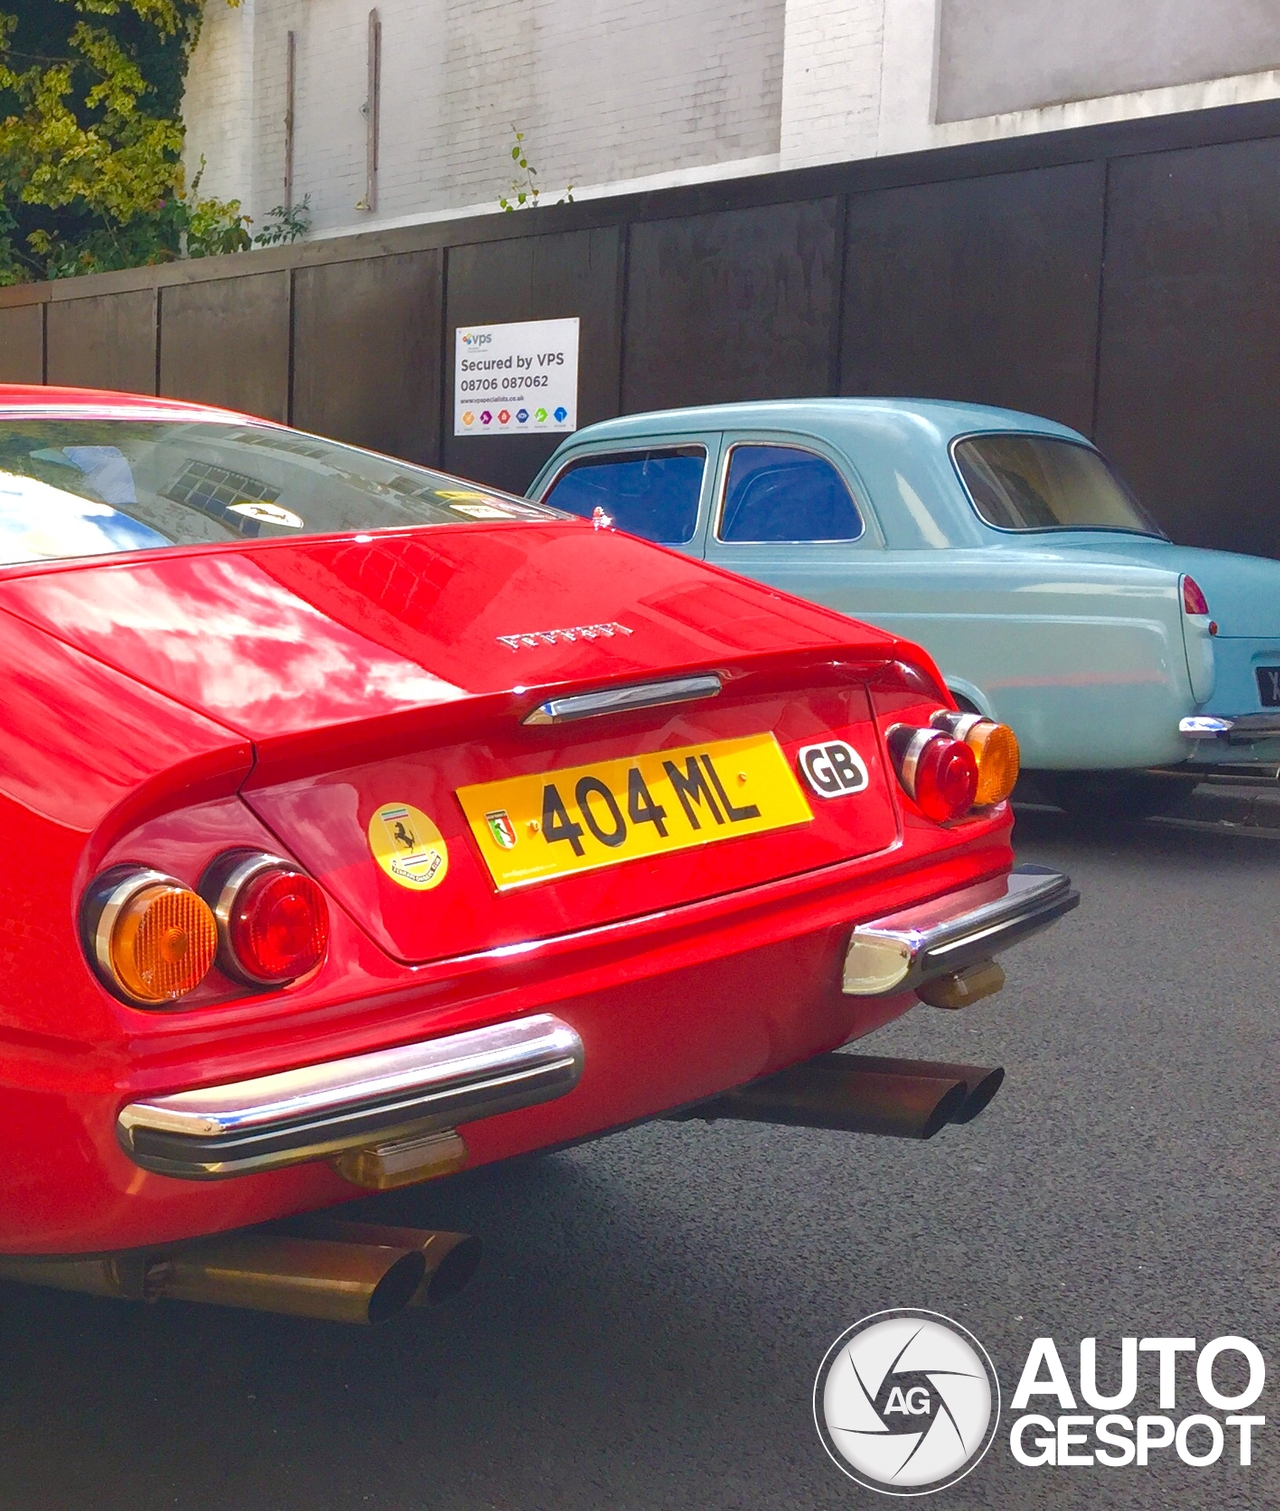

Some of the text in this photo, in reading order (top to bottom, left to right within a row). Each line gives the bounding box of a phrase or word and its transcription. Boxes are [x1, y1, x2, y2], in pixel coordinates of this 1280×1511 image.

[472, 333, 492, 347] vps
[460, 352, 565, 372] Secured by VPS
[460, 375, 549, 392] 08706 087062
[805, 745, 865, 794] GB
[541, 753, 761, 857] 404 ML
